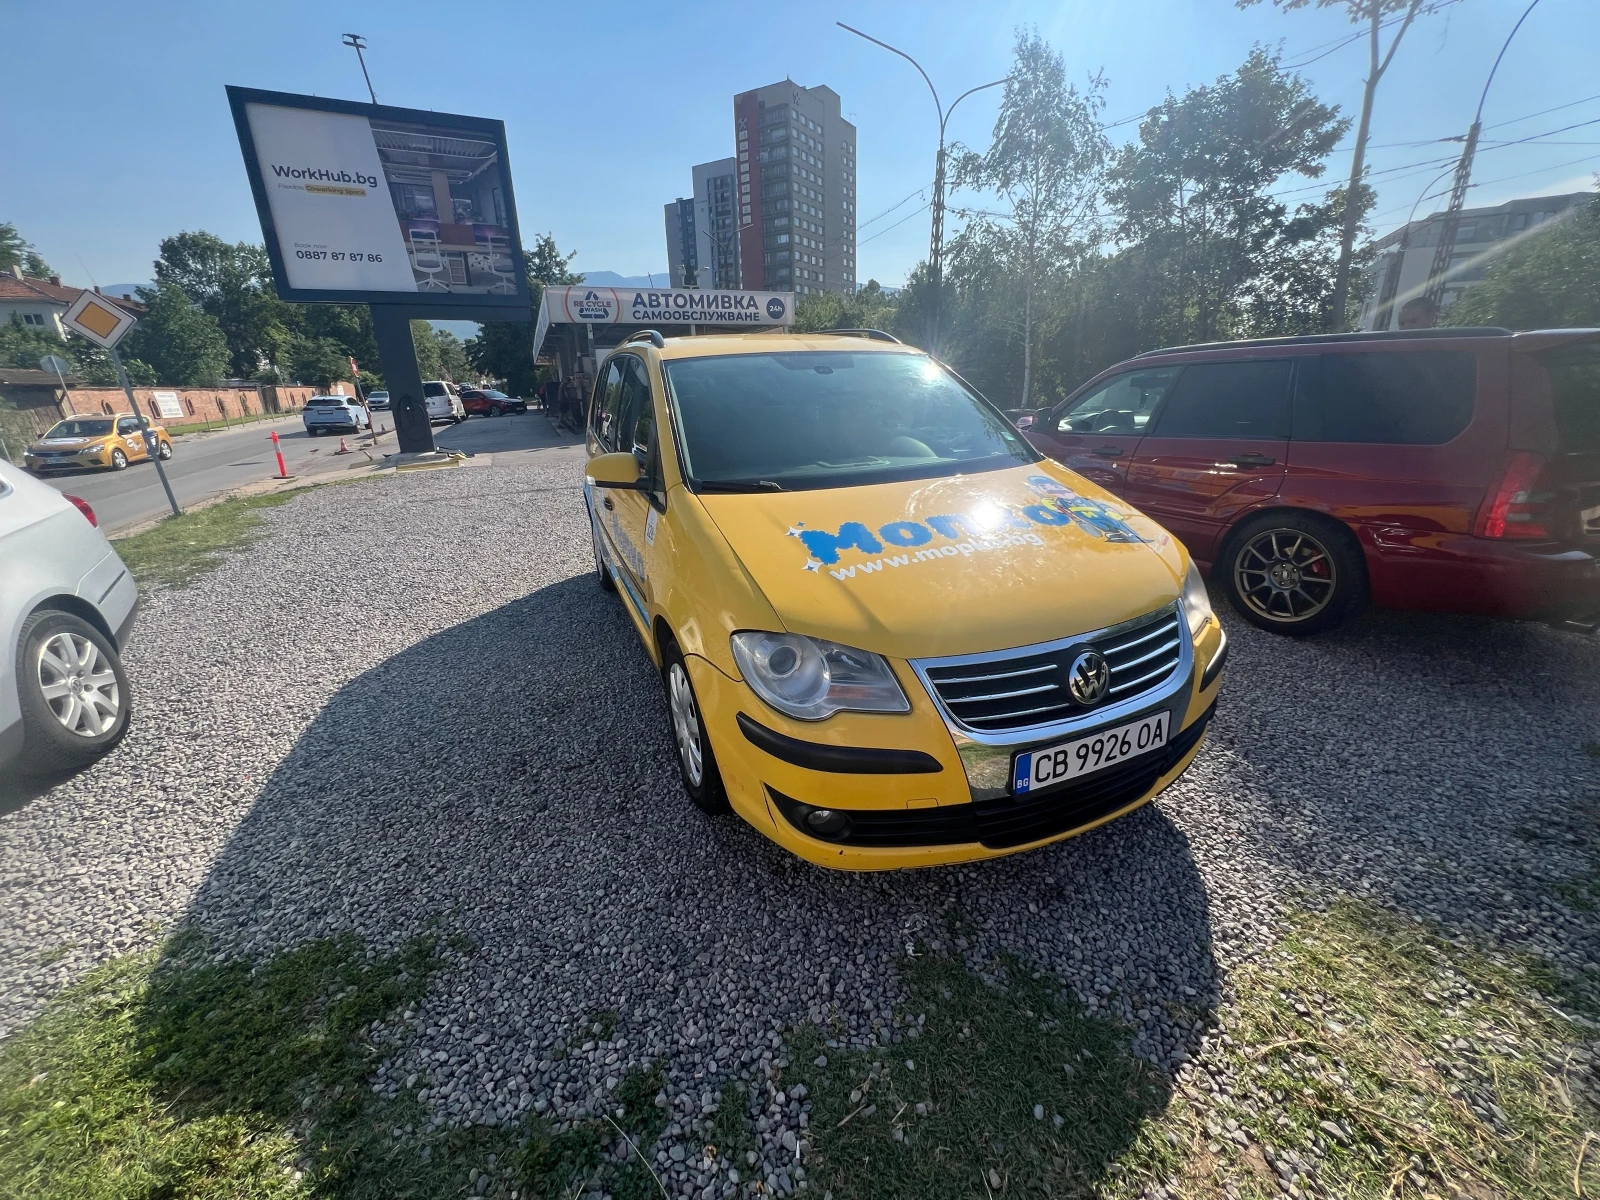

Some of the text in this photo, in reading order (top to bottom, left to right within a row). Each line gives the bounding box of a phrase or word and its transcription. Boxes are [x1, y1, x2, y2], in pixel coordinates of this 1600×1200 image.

[271, 164, 378, 188] WorkHub.bg
[305, 185, 344, 195] Coworking
[345, 188, 366, 196] Space
[296, 250, 383, 263] 0887 87 87 86
[632, 292, 759, 310] АВТОМИВКА
[632, 310, 760, 322] САМООБСЛУЖВАНЕ
[1034, 718, 1163, 783] CB 9926 OA
[1016, 777, 1029, 789] BG
